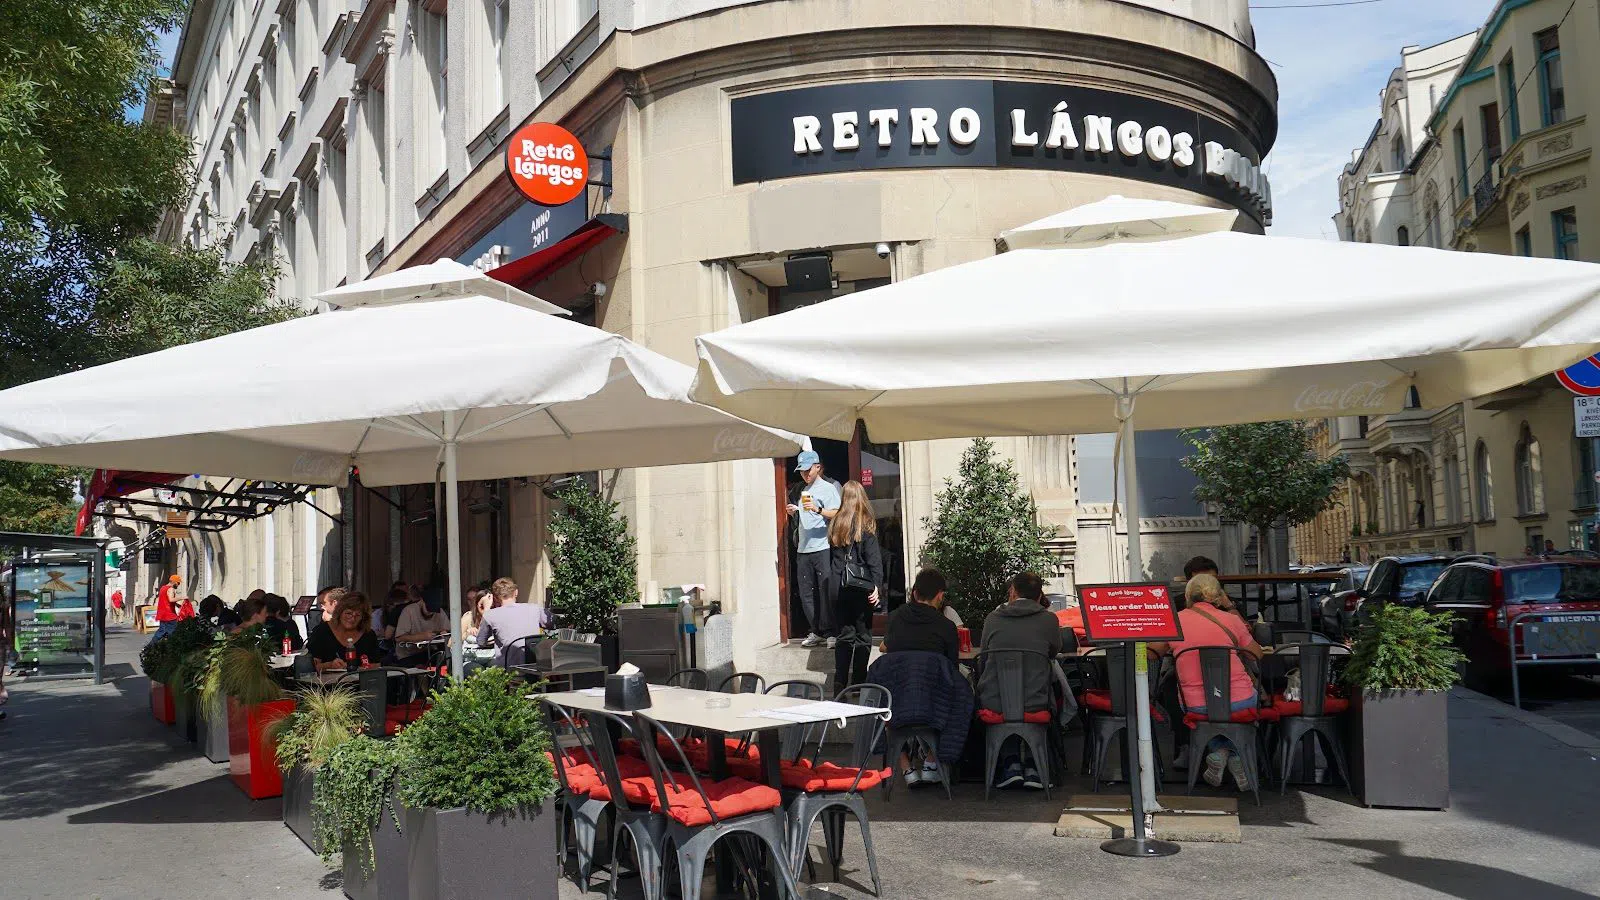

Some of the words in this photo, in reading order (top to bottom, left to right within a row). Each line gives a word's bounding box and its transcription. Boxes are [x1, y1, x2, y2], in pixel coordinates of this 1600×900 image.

[793, 107, 981, 154] RETRO
[1010, 100, 1195, 167] LÁNGOS
[530, 209, 551, 234] ANNO
[532, 226, 549, 249] 2011
[1089, 604, 1117, 612] Please
[1118, 603, 1143, 611] order
[1144, 602, 1169, 610] inside
